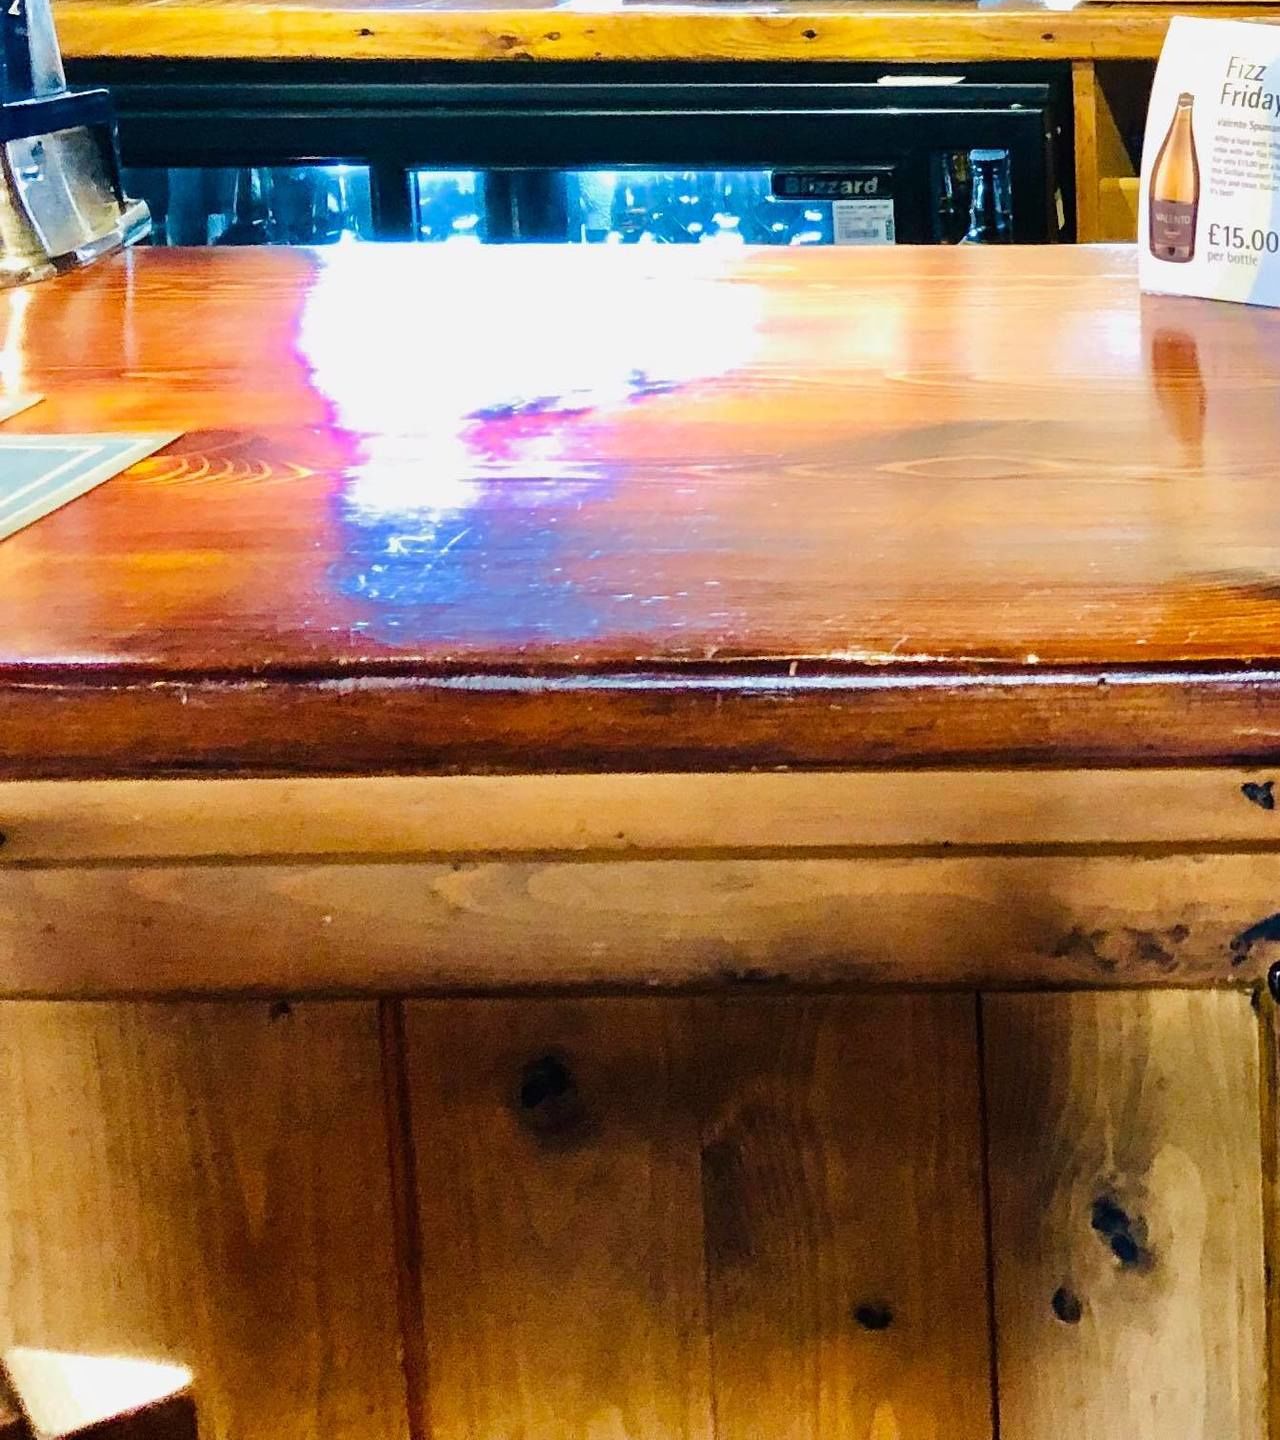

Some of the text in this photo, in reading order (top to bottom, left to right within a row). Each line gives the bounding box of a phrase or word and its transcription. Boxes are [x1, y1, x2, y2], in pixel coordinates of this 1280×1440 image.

[1226, 56, 1267, 82] Fizz
[785, 177, 878, 194] Blizzard
[1208, 223, 1279, 254] £15.00
[1207, 251, 1258, 266] per bottle
